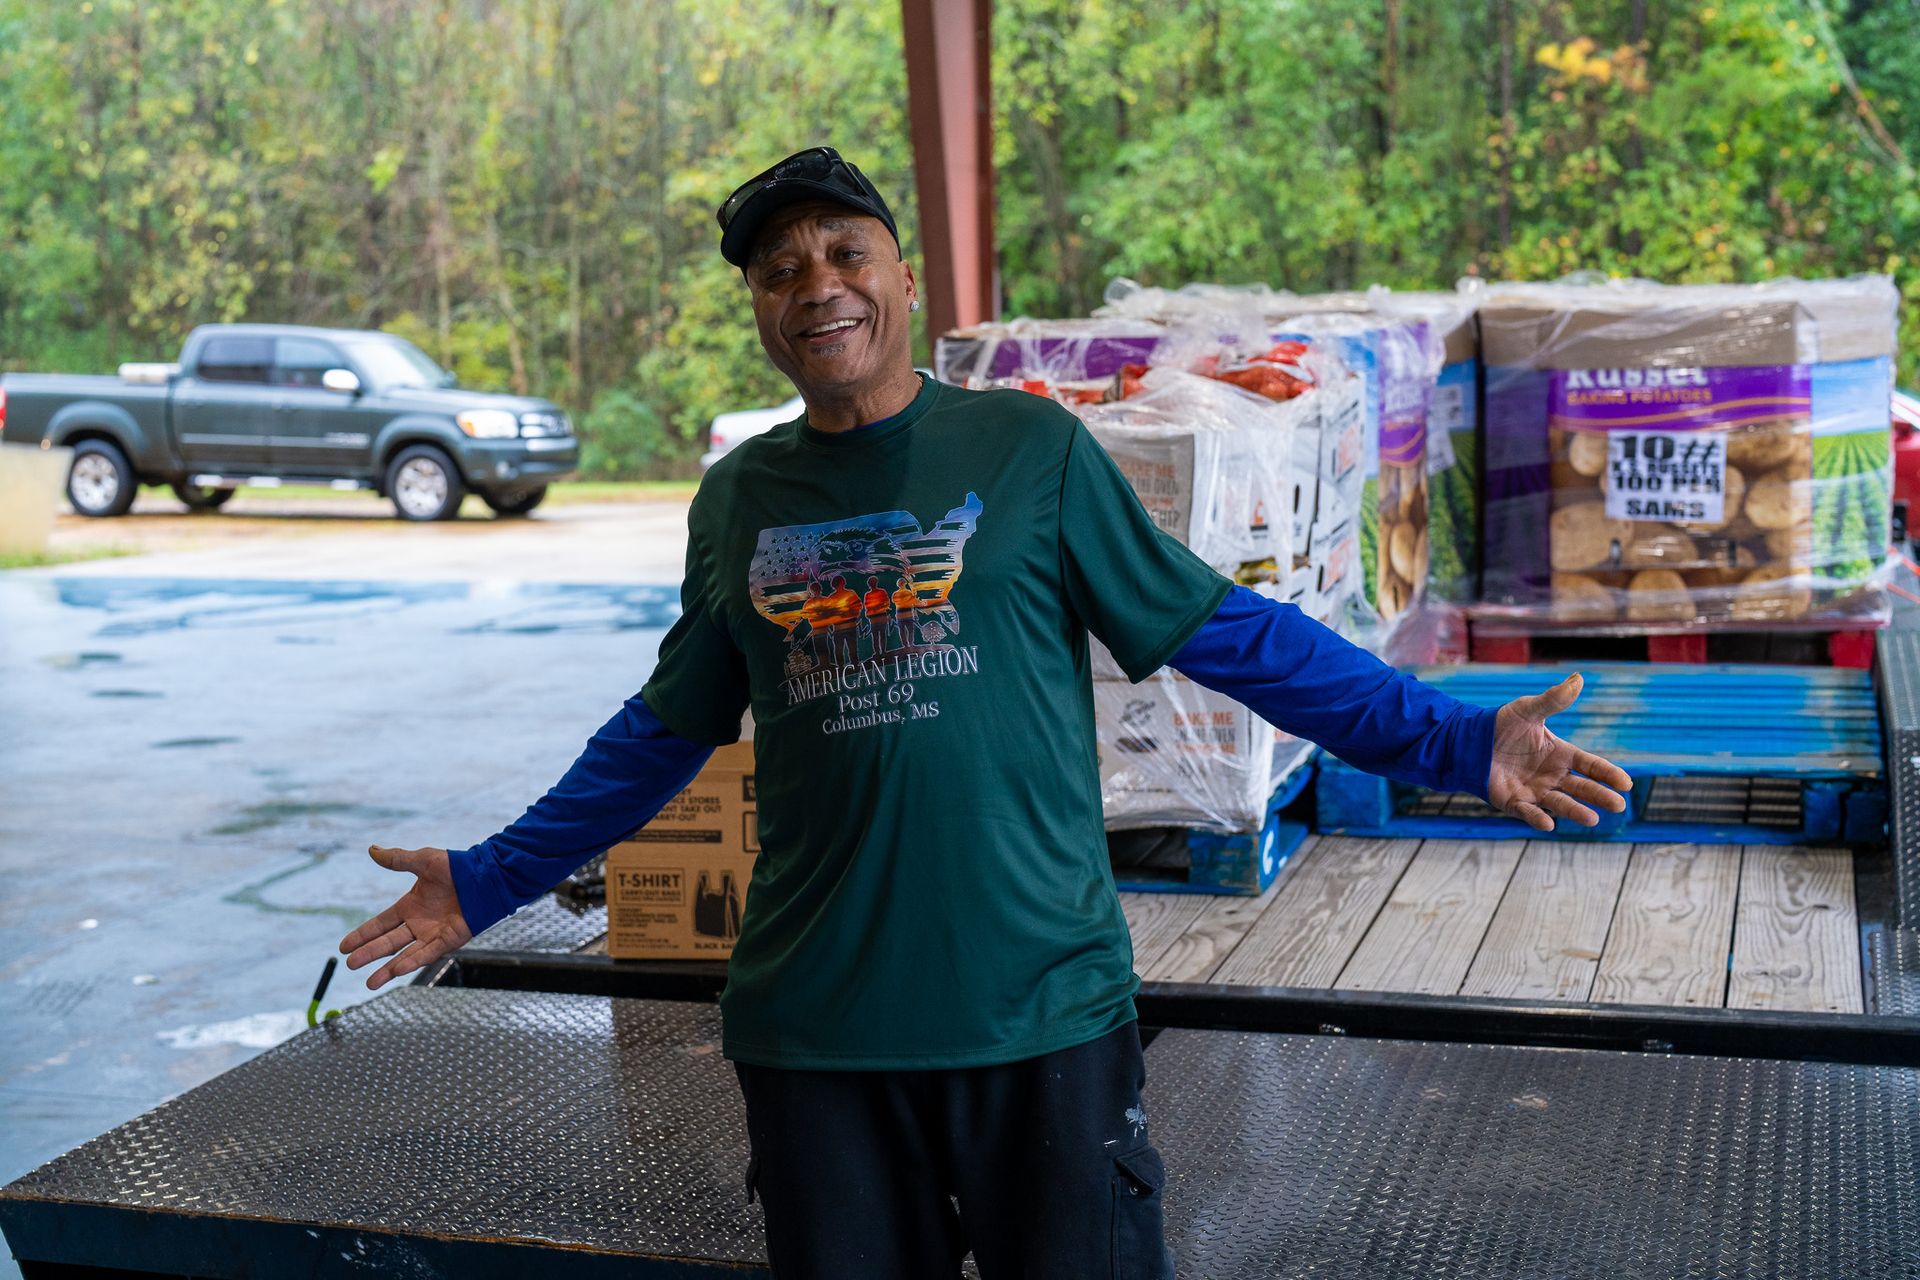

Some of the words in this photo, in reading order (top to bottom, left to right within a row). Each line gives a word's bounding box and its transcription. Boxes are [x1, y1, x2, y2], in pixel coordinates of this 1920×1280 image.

[1566, 367, 1708, 389] Russet
[1567, 390, 1628, 405] BAKING
[1631, 389, 1712, 404] POTATOES
[1616, 476, 1662, 491] 100
[1672, 477, 1720, 494] PER
[1627, 499, 1705, 518] SAMS
[788, 658, 887, 706] AMERICAN
[893, 645, 980, 682] LEGION
[839, 690, 881, 714] Post
[888, 682, 915, 705] 69
[822, 708, 906, 735] Columbus,
[911, 701, 941, 720] MS
[1213, 711, 1233, 725] ME
[689, 796, 721, 804] STORES
[680, 805, 701, 813] TAKE
[703, 805, 722, 813] OUT
[655, 813, 696, 822] ARRY-OUT
[618, 873, 681, 888] T-SHIRT
[694, 942, 719, 950] BLACK
